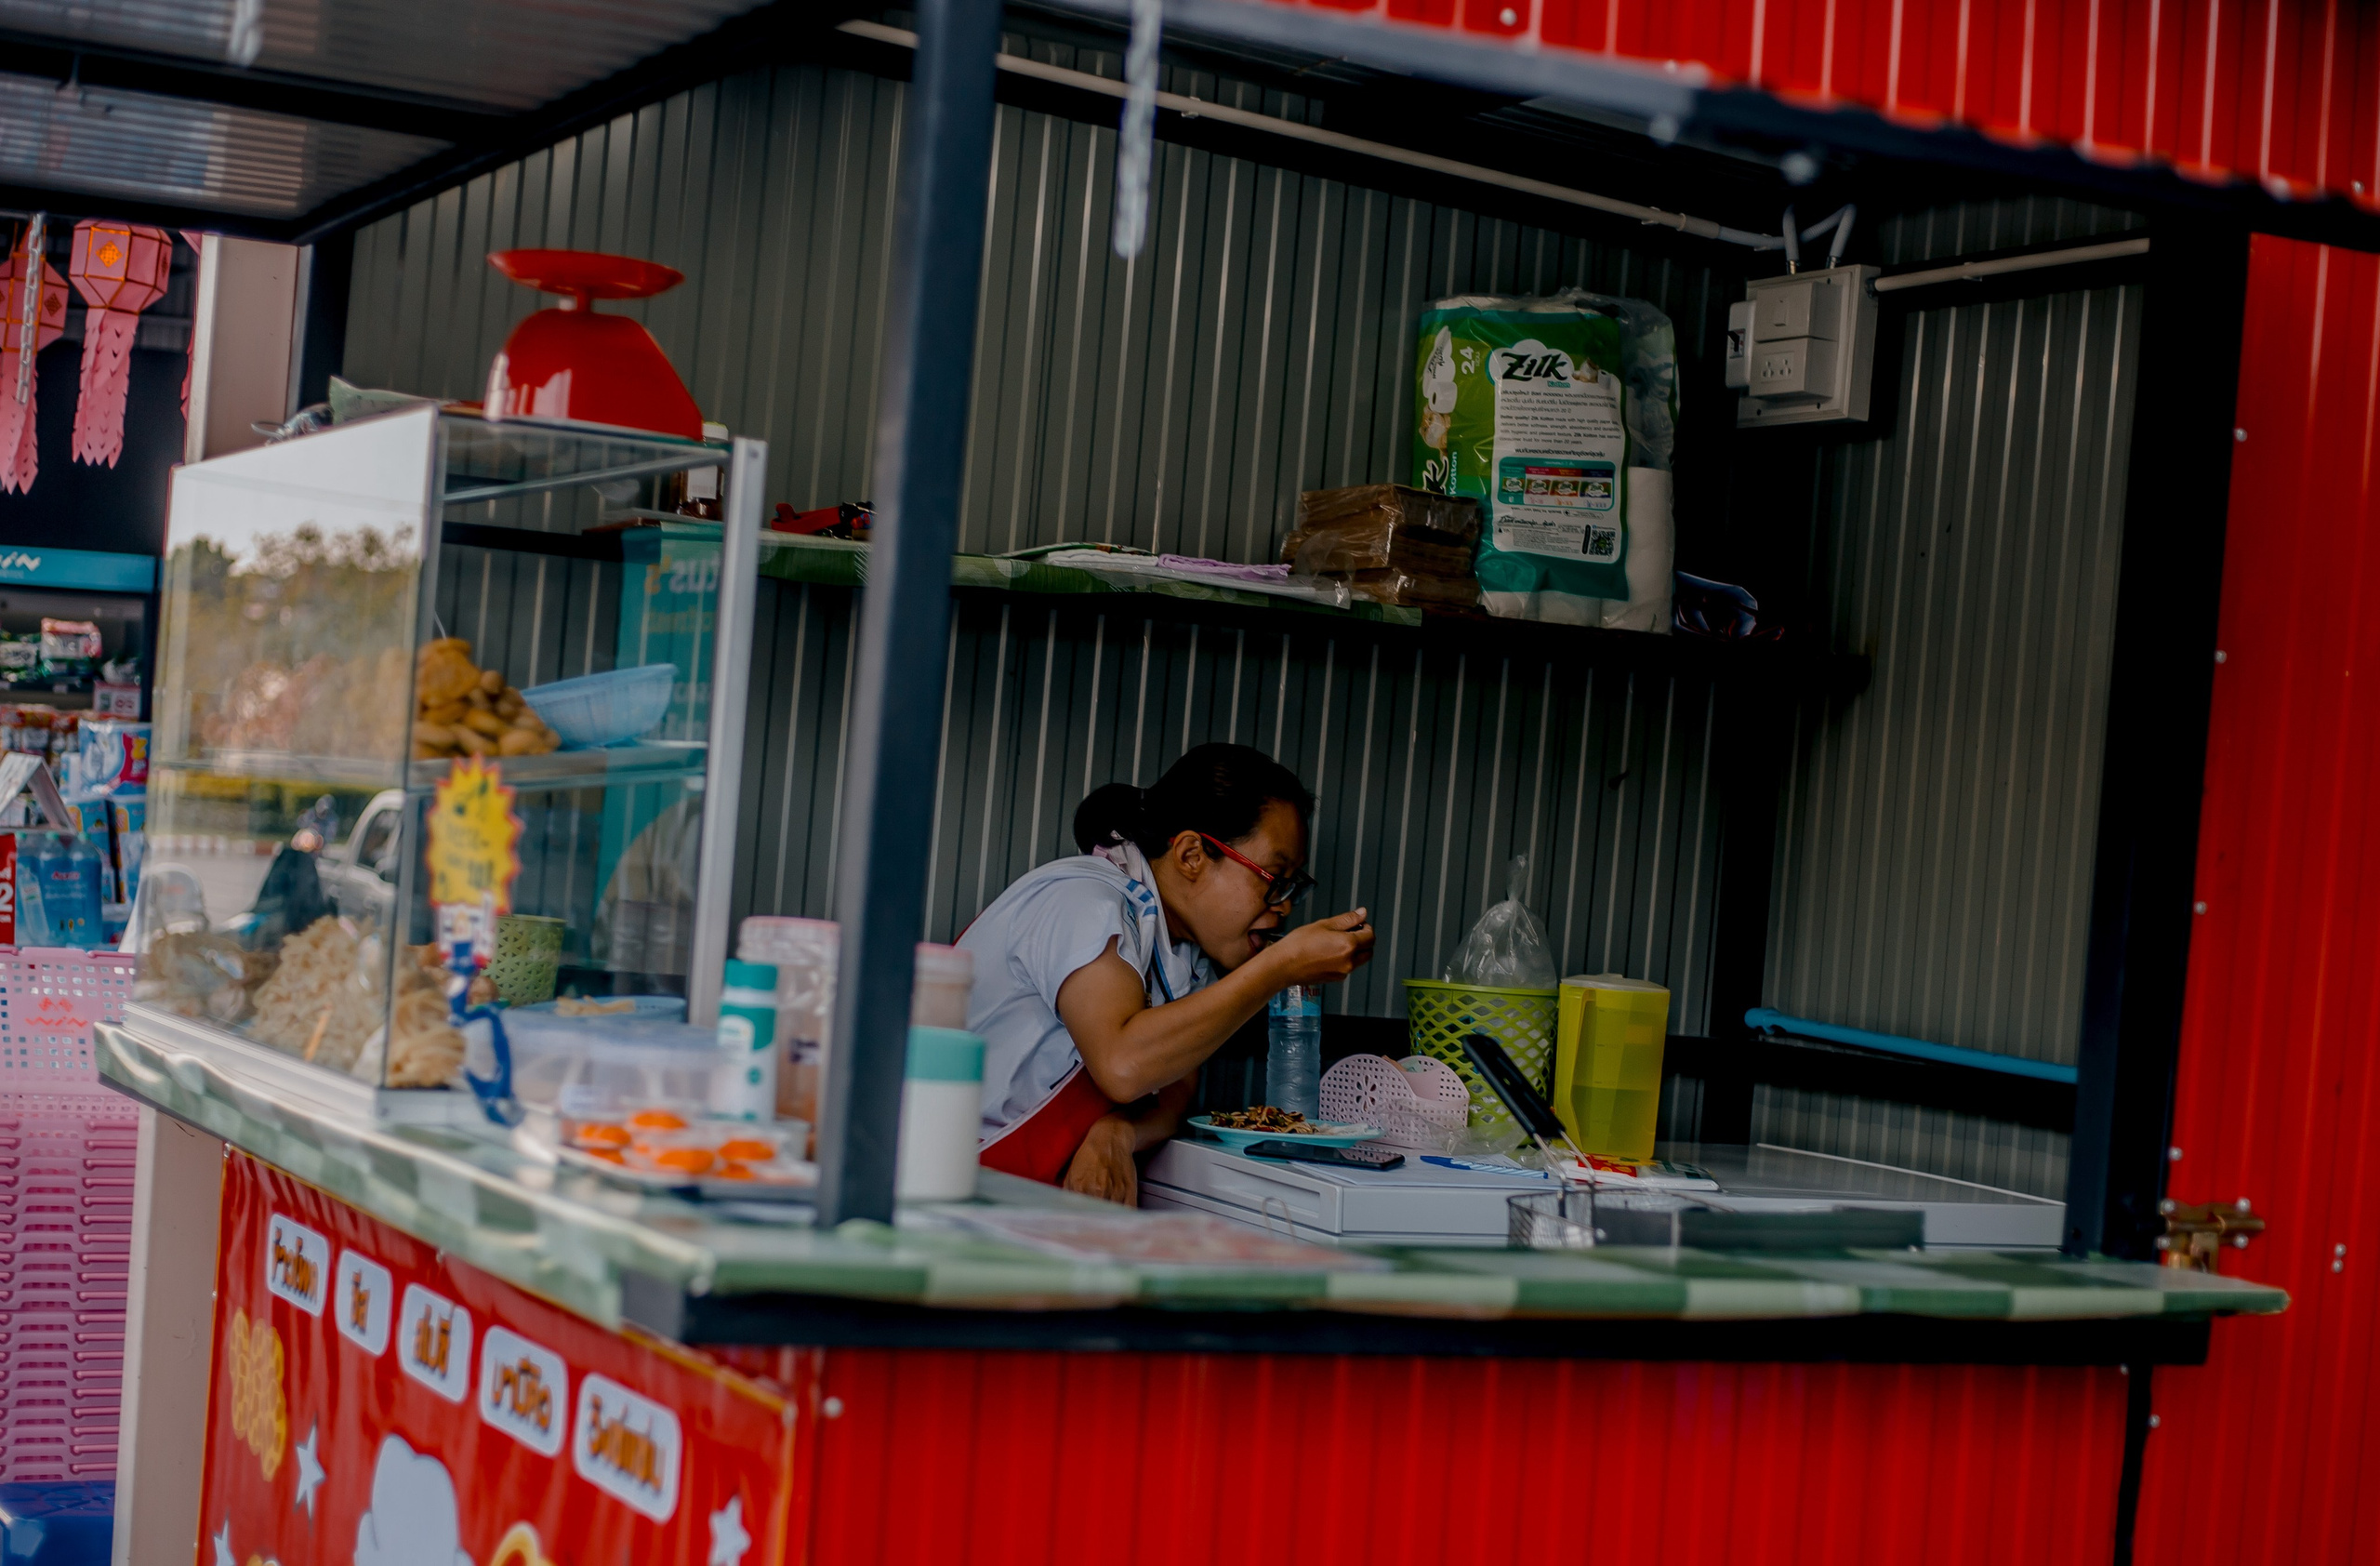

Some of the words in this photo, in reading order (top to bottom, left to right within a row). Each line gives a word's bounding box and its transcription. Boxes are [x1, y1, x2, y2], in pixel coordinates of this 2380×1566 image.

[1460, 346, 1475, 374] 24
[1501, 352, 1567, 381] Zilk
[1449, 451, 1457, 495] Kotton
